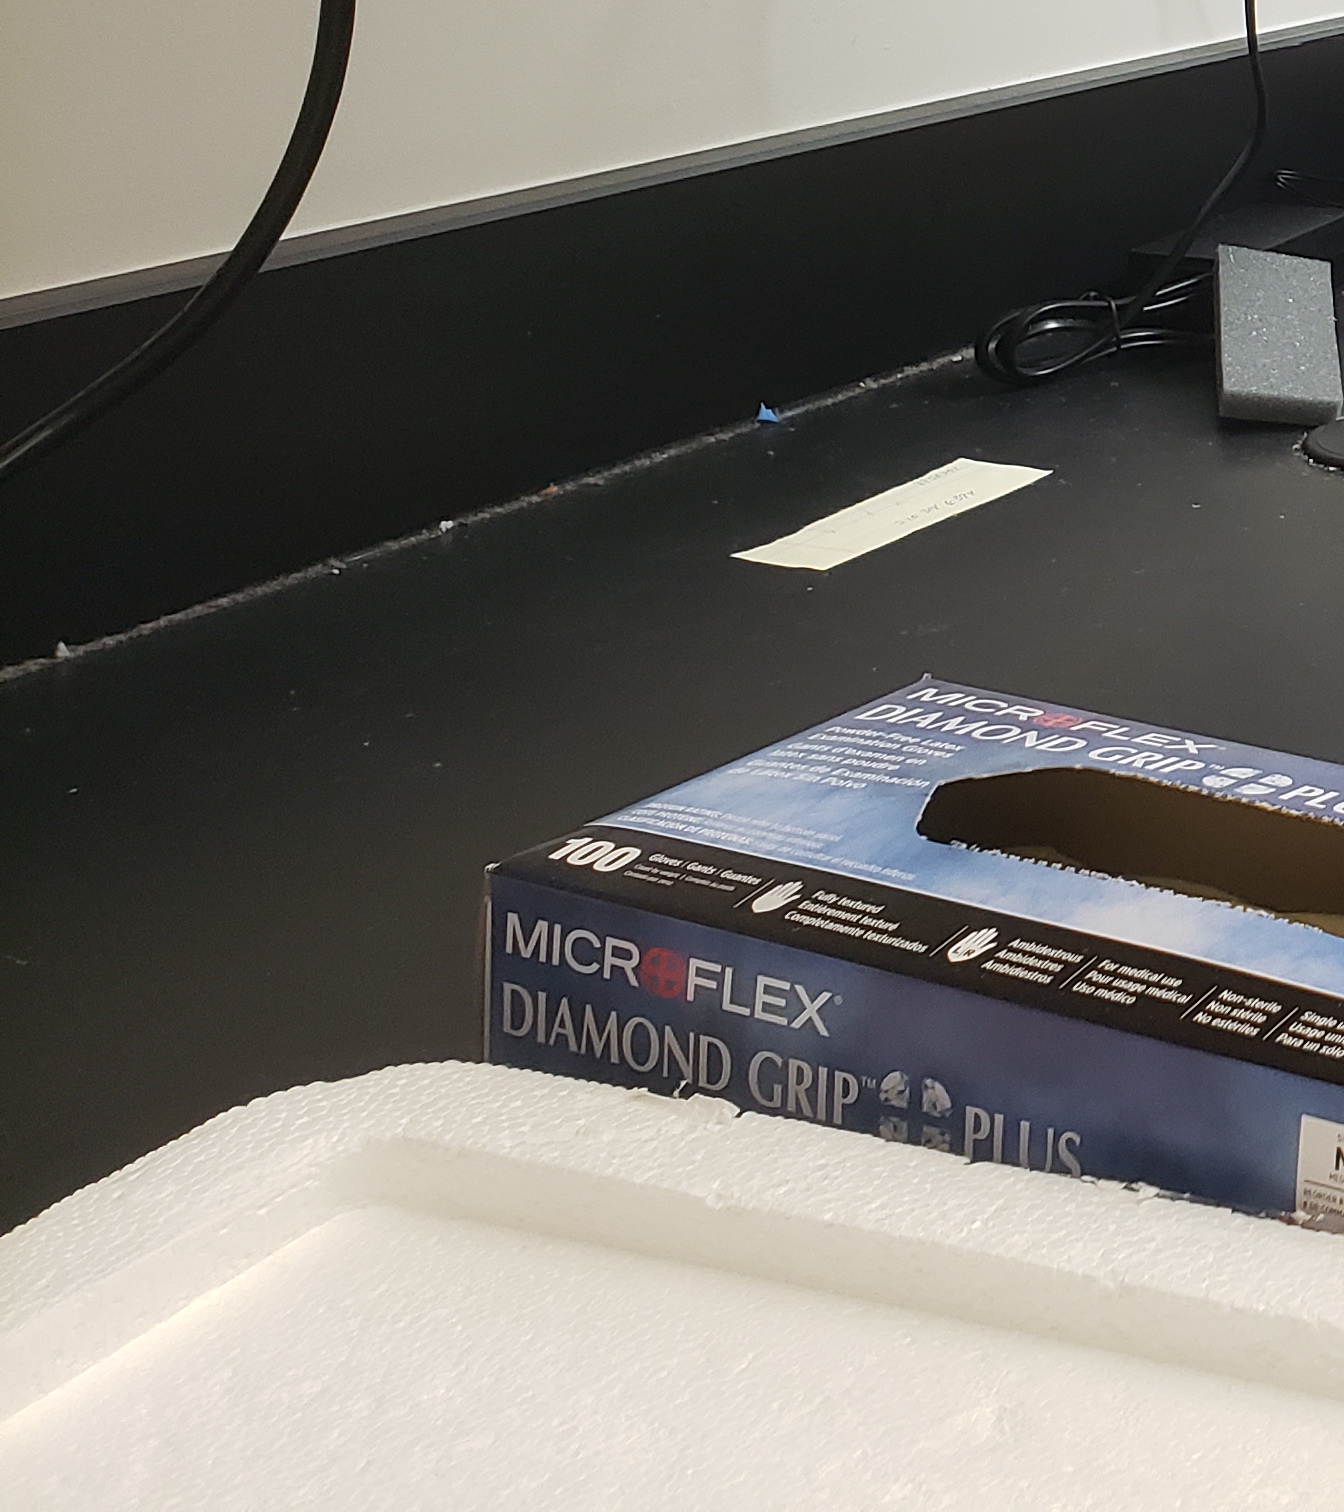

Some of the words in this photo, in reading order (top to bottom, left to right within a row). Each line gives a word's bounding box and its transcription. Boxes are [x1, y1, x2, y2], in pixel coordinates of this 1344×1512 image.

[854, 703, 1088, 752] DIAMOND
[807, 754, 841, 764] sans
[901, 745, 955, 759] Gloves
[906, 757, 927, 767] en
[808, 763, 831, 775] de
[548, 836, 643, 873] 100
[649, 853, 683, 867] Gloves
[687, 862, 717, 875] Gants
[720, 869, 762, 885] Guantes
[811, 890, 840, 905] Fully
[839, 894, 886, 914] textured
[784, 910, 863, 938] Completamente
[863, 930, 929, 953] texturizados
[995, 949, 1064, 973] Ambidextres
[1008, 938, 1086, 964] Ambidextrous
[981, 959, 1054, 984] Ambidiestros
[1097, 959, 1118, 972] For
[1118, 963, 1162, 983] medical
[1161, 976, 1183, 987] use
[1072, 982, 1093, 994] Uso
[1093, 986, 1137, 1005] médico
[1086, 970, 1114, 985] Pour
[1114, 978, 1147, 995] usage
[1147, 983, 1192, 1004] médical
[1206, 1000, 1230, 1015] Non
[1230, 1006, 1268, 1024] stérile
[1218, 989, 1282, 1014] Non-sterile
[1193, 1011, 1212, 1024] No
[1300, 1011, 1338, 1029] Single
[502, 982, 732, 1092] DIAMOND
[1275, 1033, 1303, 1048] Para
[1303, 1041, 1321, 1051] un
[1288, 1021, 1325, 1039] Usage
